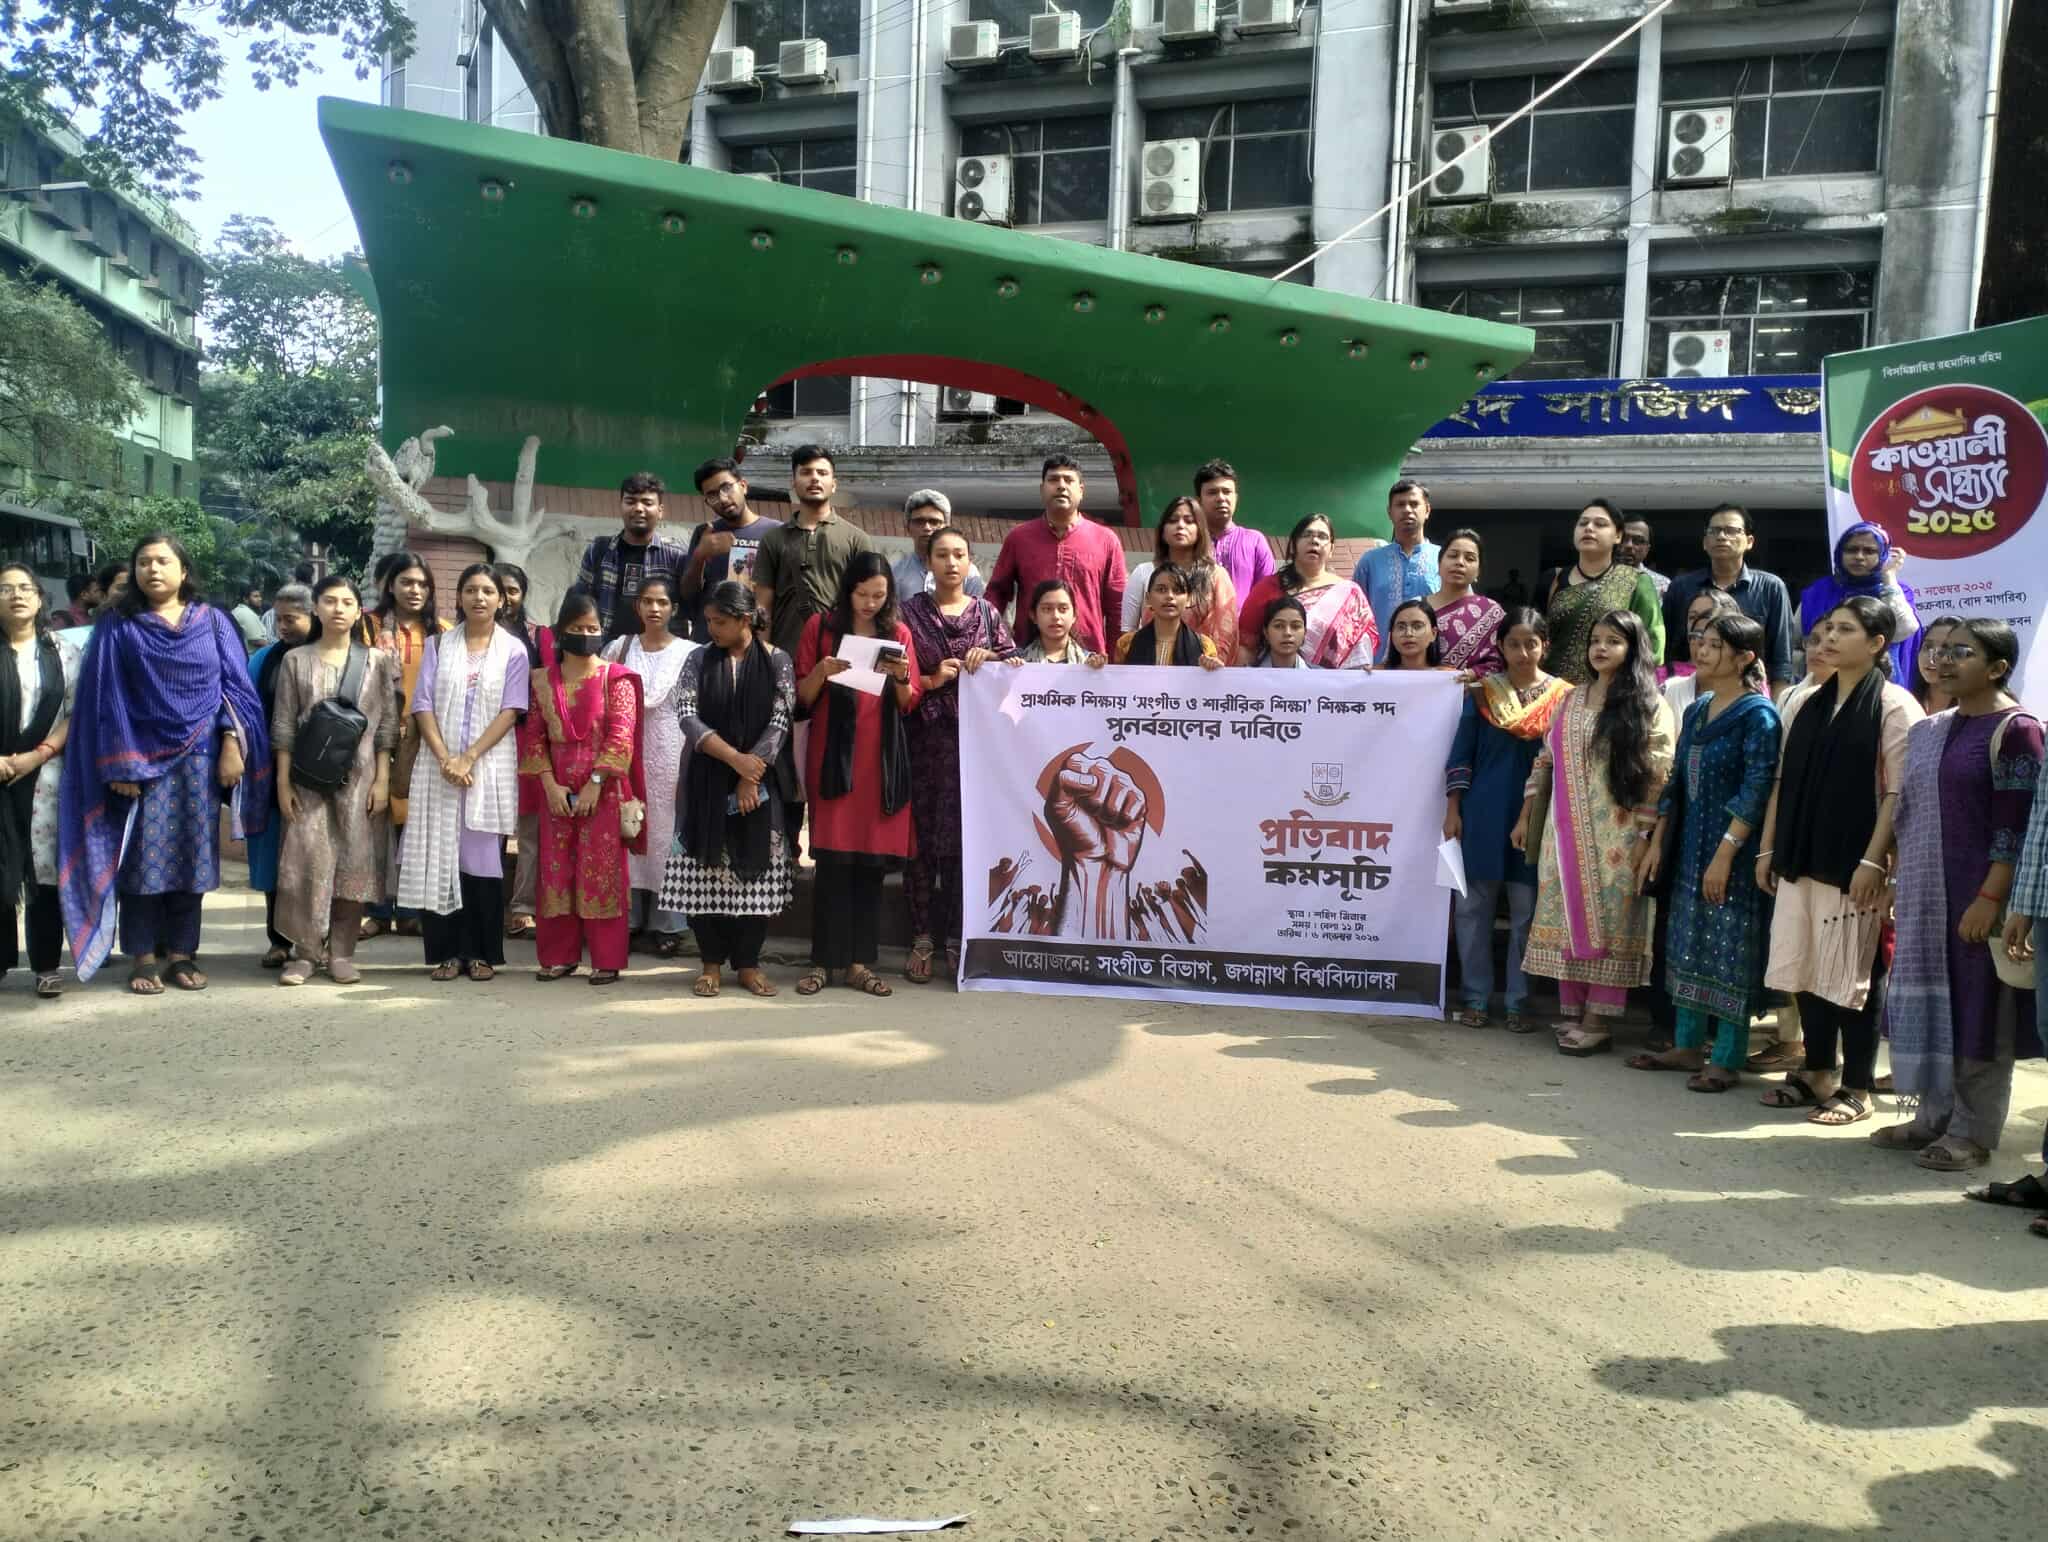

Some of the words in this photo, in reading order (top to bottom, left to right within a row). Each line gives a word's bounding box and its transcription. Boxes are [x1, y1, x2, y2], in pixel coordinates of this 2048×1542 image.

[1538, 378, 1751, 424] সাজিদ
[1868, 414, 2007, 473] কাওয়ালী
[1918, 459, 2009, 510] সন্ধ্যা
[1908, 507, 1997, 534] ২০২৫
[1925, 585, 1962, 598] নভেম্বর
[1963, 581, 1993, 592] ২০২৫
[1958, 595, 1983, 609] (বাদ
[1984, 589, 2027, 605] মাগরিব)
[1021, 690, 1077, 708] প্রাথমিক
[1081, 691, 1127, 711] শিক্ষায়
[1185, 698, 1198, 711] ও
[1202, 694, 1265, 714] শারীরিক
[1317, 696, 1367, 715] শিক্ষক
[1372, 701, 1397, 716] পদ
[1105, 711, 1222, 742] পুনর্বহালের
[1230, 714, 1303, 743] দাবিতে
[1258, 809, 1393, 856] প্রতিবাদ
[1263, 849, 1392, 901] কর্মসূচি
[1095, 950, 1156, 977] সংগীত
[1159, 953, 1218, 984] বিভাগ,
[1223, 961, 1289, 988] জগন্নাথ
[1292, 960, 1400, 992] বিশ্ববিদ্যালয়
